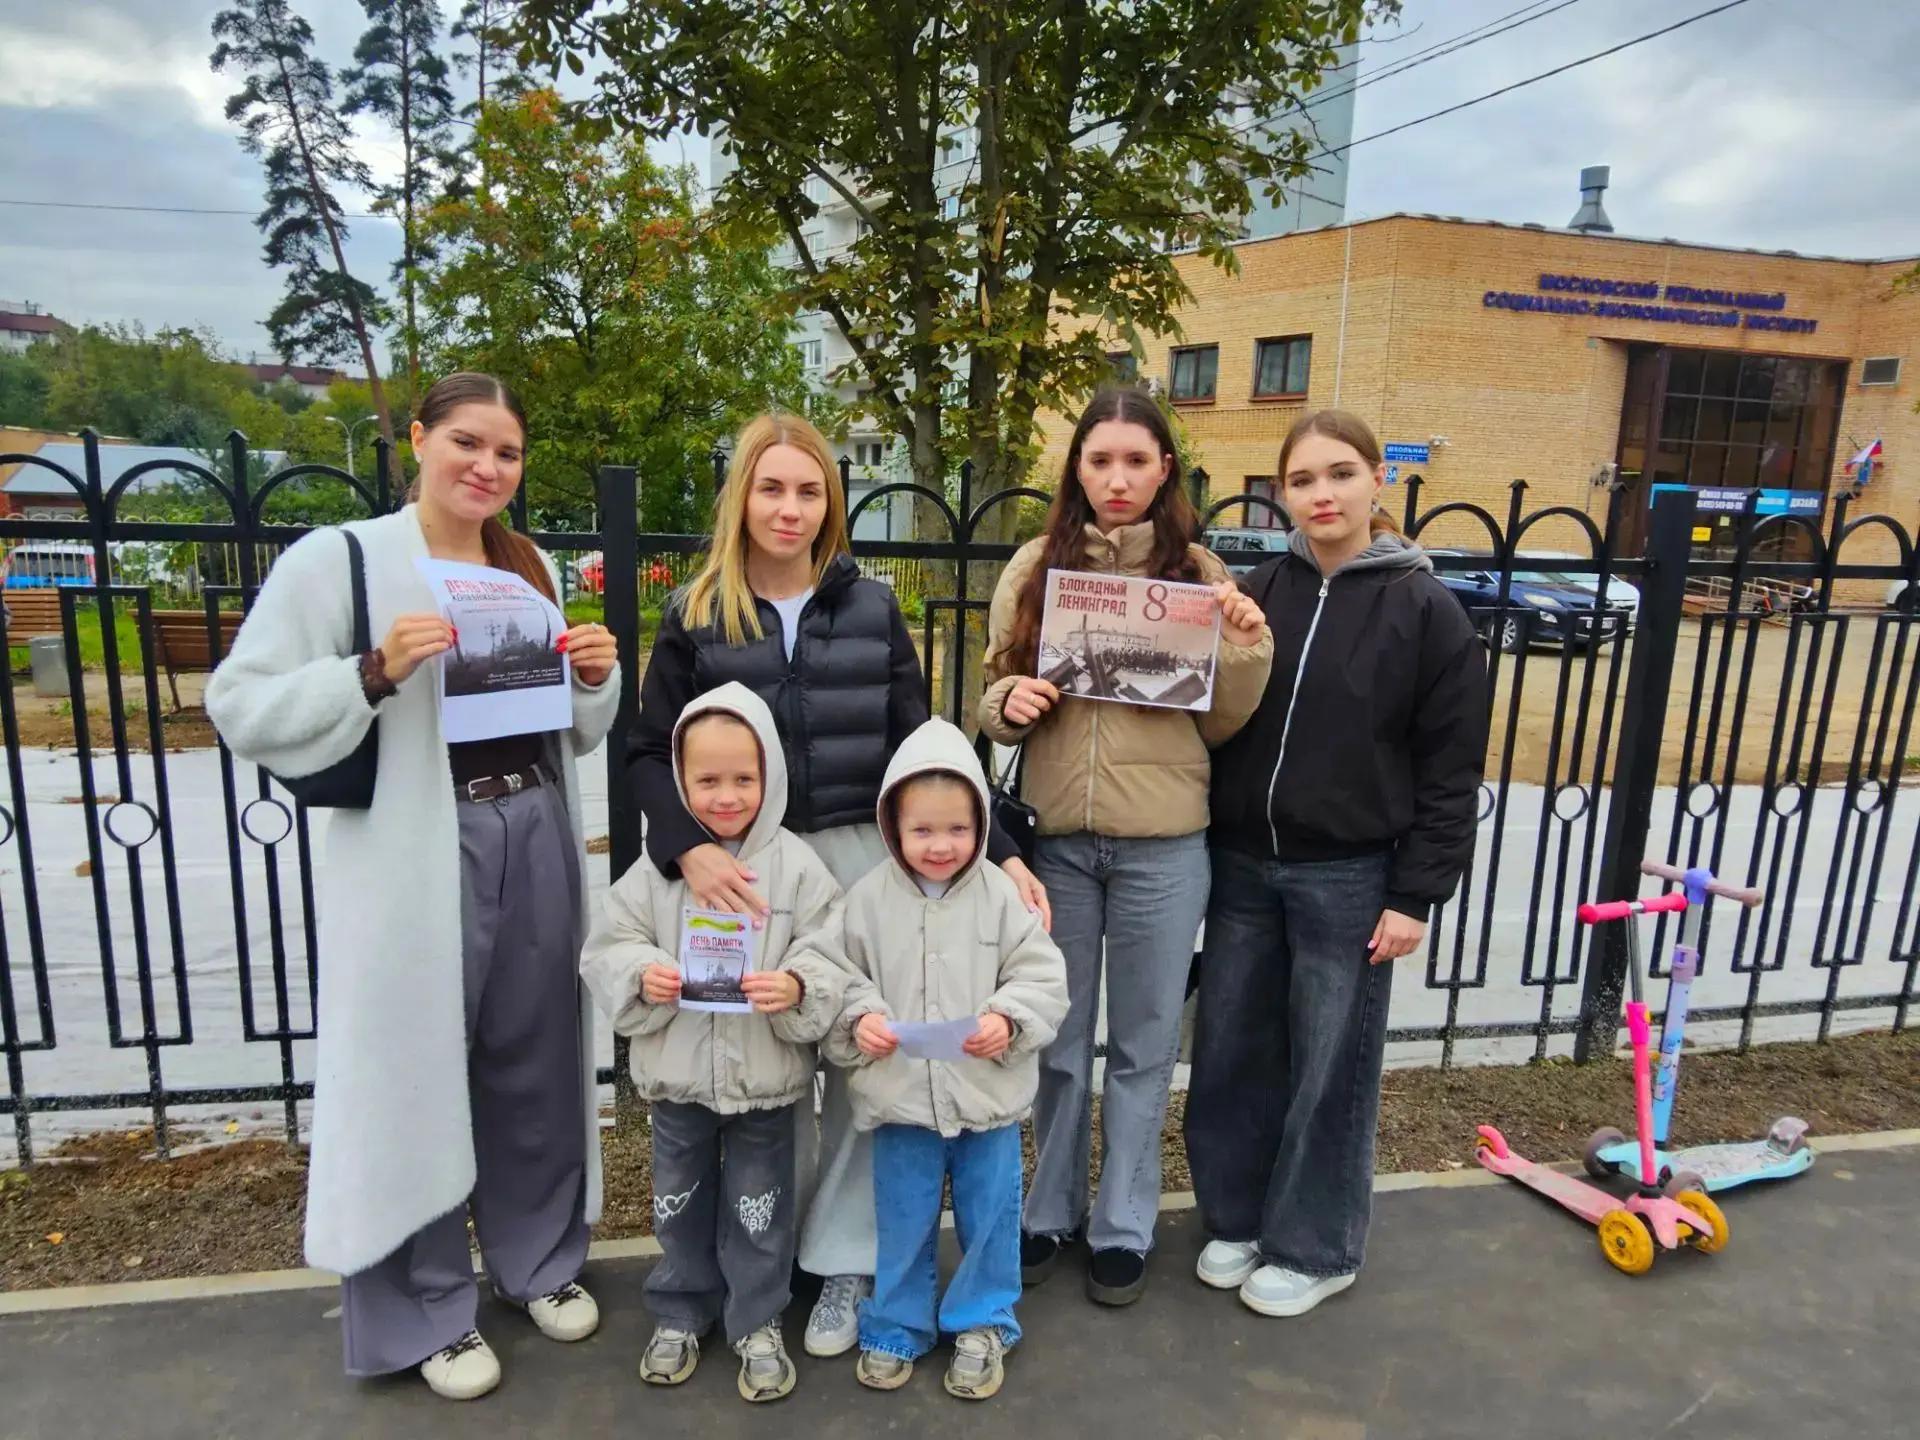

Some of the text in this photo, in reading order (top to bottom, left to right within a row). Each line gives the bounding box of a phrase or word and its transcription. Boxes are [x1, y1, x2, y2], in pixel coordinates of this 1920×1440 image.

[1059, 577, 1127, 596] БЛОКАДНЫЙ
[1056, 594, 1127, 617] ЛЕНИНГРАД
[1143, 583, 1168, 622] 8
[690, 935, 743, 947] ДЕНЬ ПАМЯТИ
